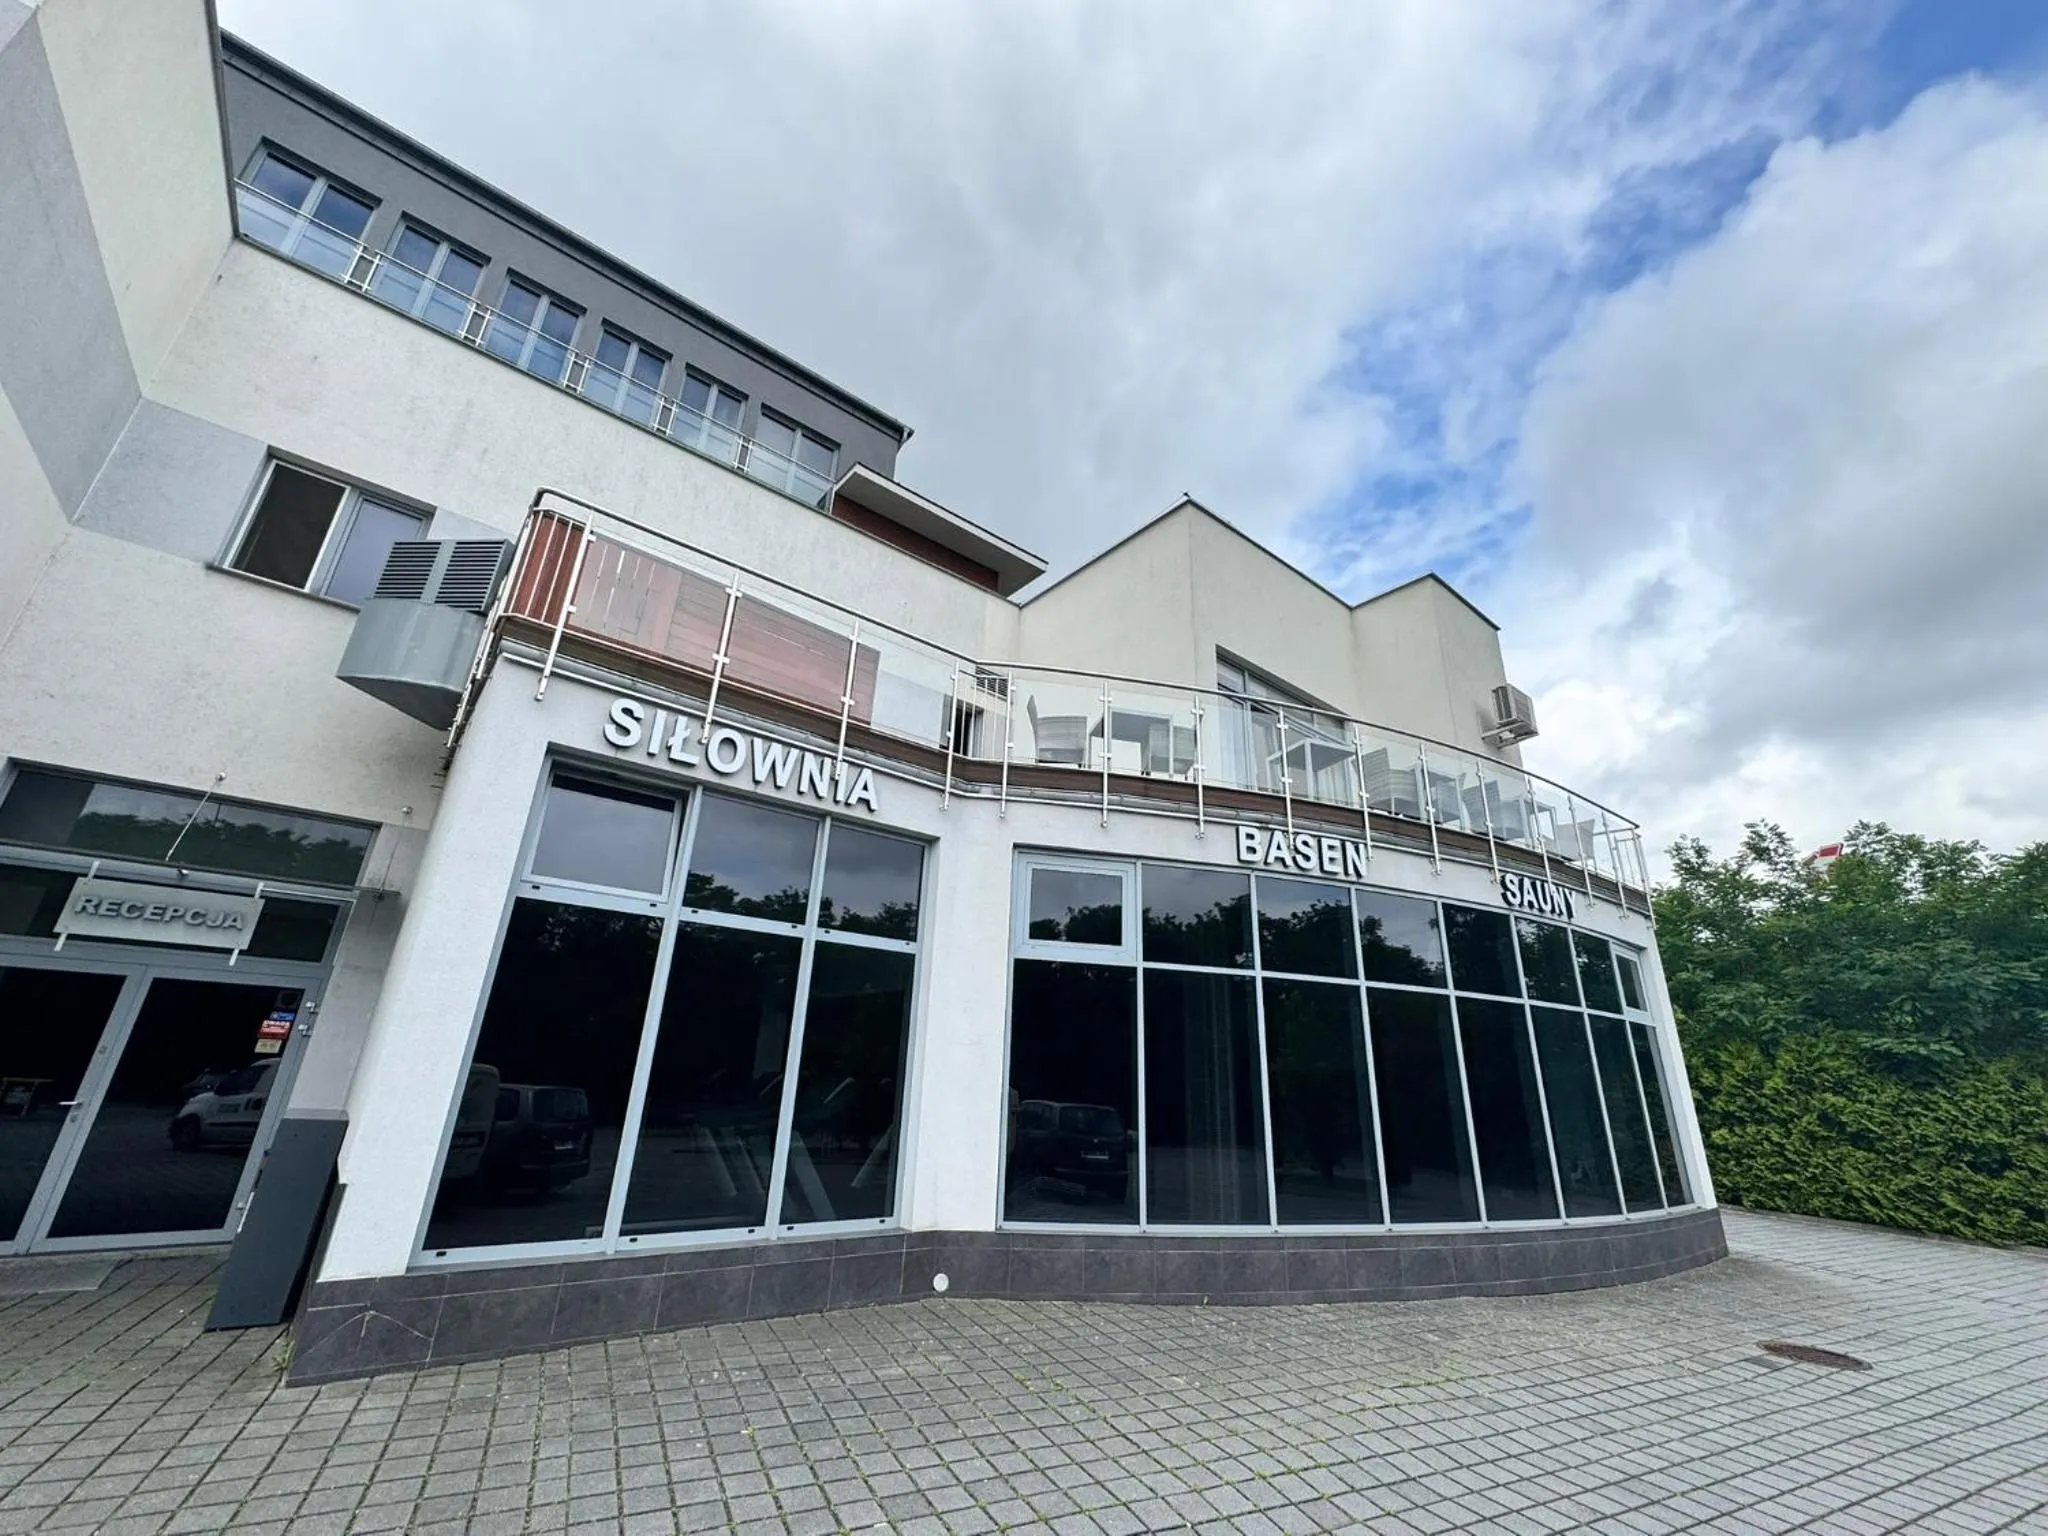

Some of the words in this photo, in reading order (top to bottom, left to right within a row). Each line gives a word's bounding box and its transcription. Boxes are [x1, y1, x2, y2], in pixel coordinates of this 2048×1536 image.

[603, 698, 878, 812] SIŁOWNIA
[1237, 825, 1368, 878] BASEN
[74, 895, 243, 931] RECEPCJA
[1501, 873, 1576, 921] SAUNY
